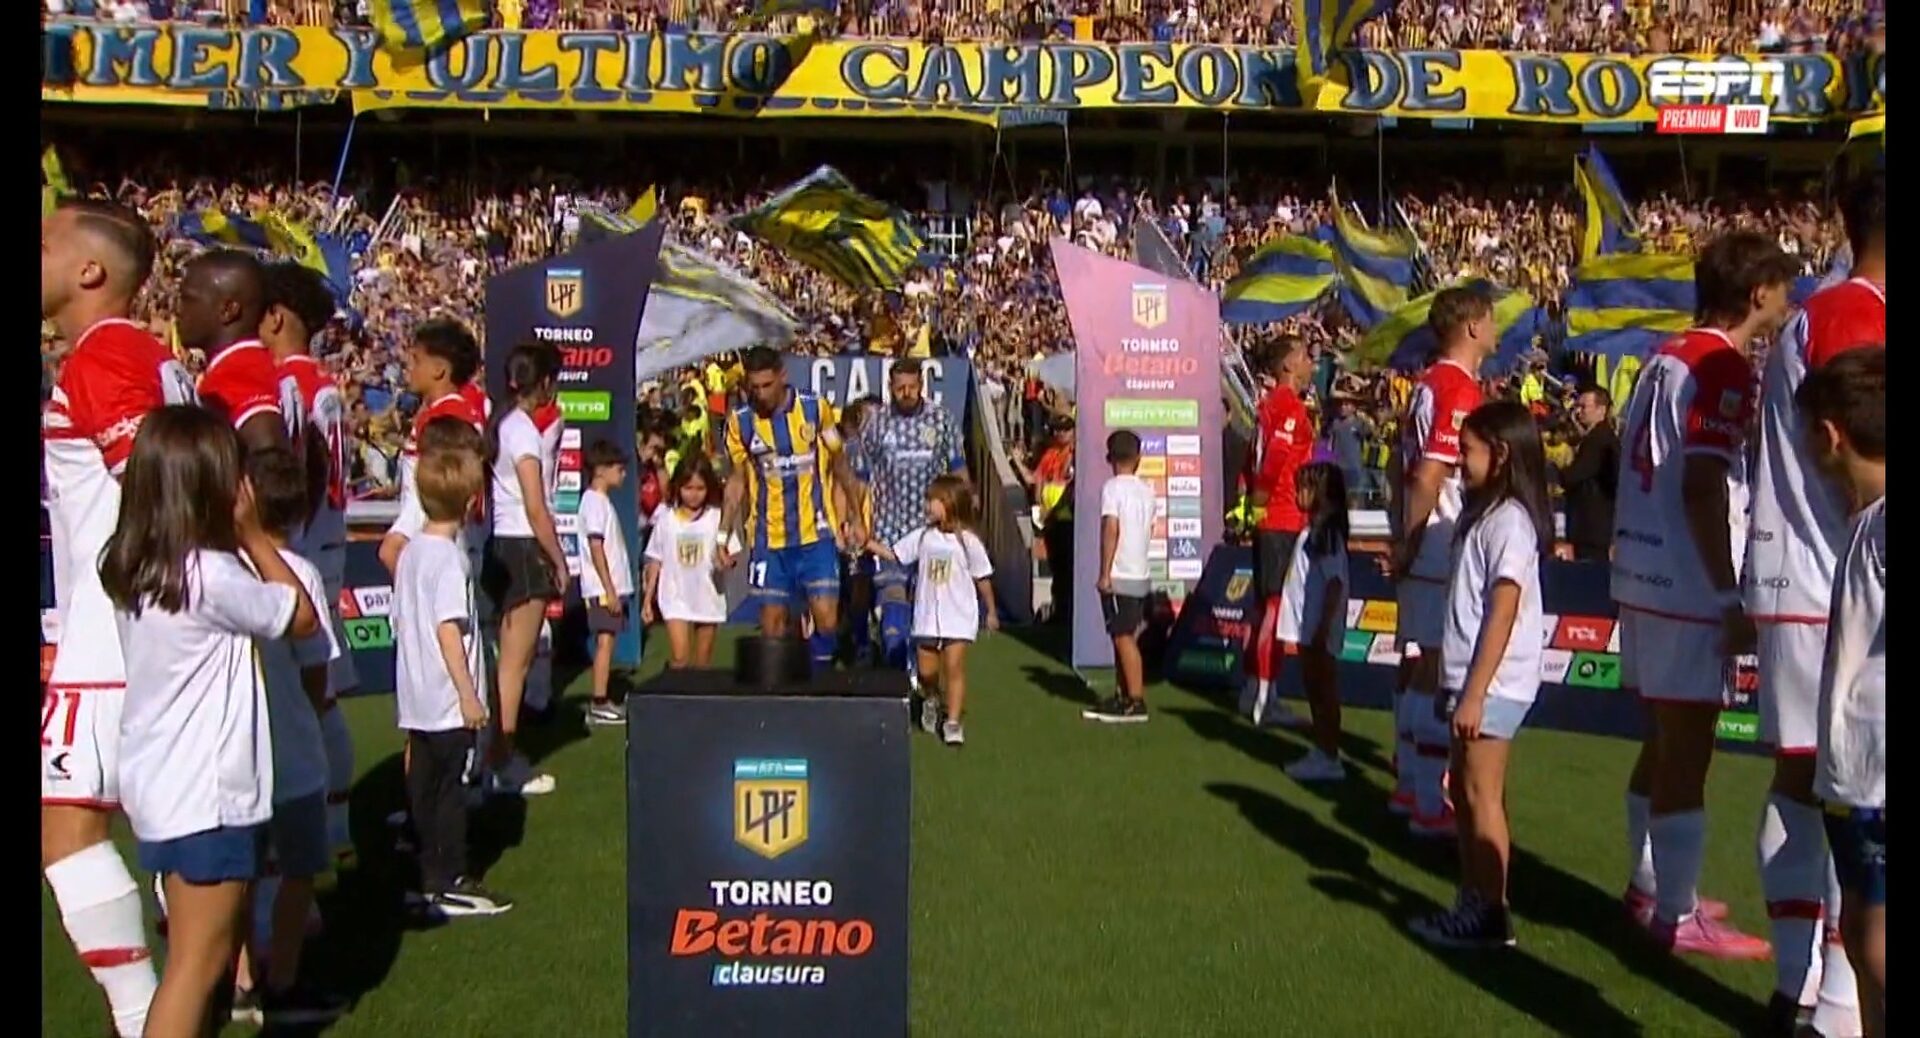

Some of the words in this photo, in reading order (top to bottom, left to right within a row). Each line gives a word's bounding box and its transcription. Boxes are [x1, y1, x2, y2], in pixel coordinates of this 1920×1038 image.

[426, 31, 783, 92] ULTIMO
[840, 42, 1301, 106] CAMPEON
[1340, 48, 1466, 109] DE
[534, 327, 594, 341] TORNEO
[1121, 337, 1180, 352] TORNEO
[1103, 352, 1198, 377] Betano
[1126, 377, 1175, 390] clausura
[1566, 625, 1600, 642] TCL
[745, 790, 797, 844] LPF
[711, 880, 833, 906] TORNEO
[671, 909, 874, 956] Betano
[714, 961, 826, 986] clausura
